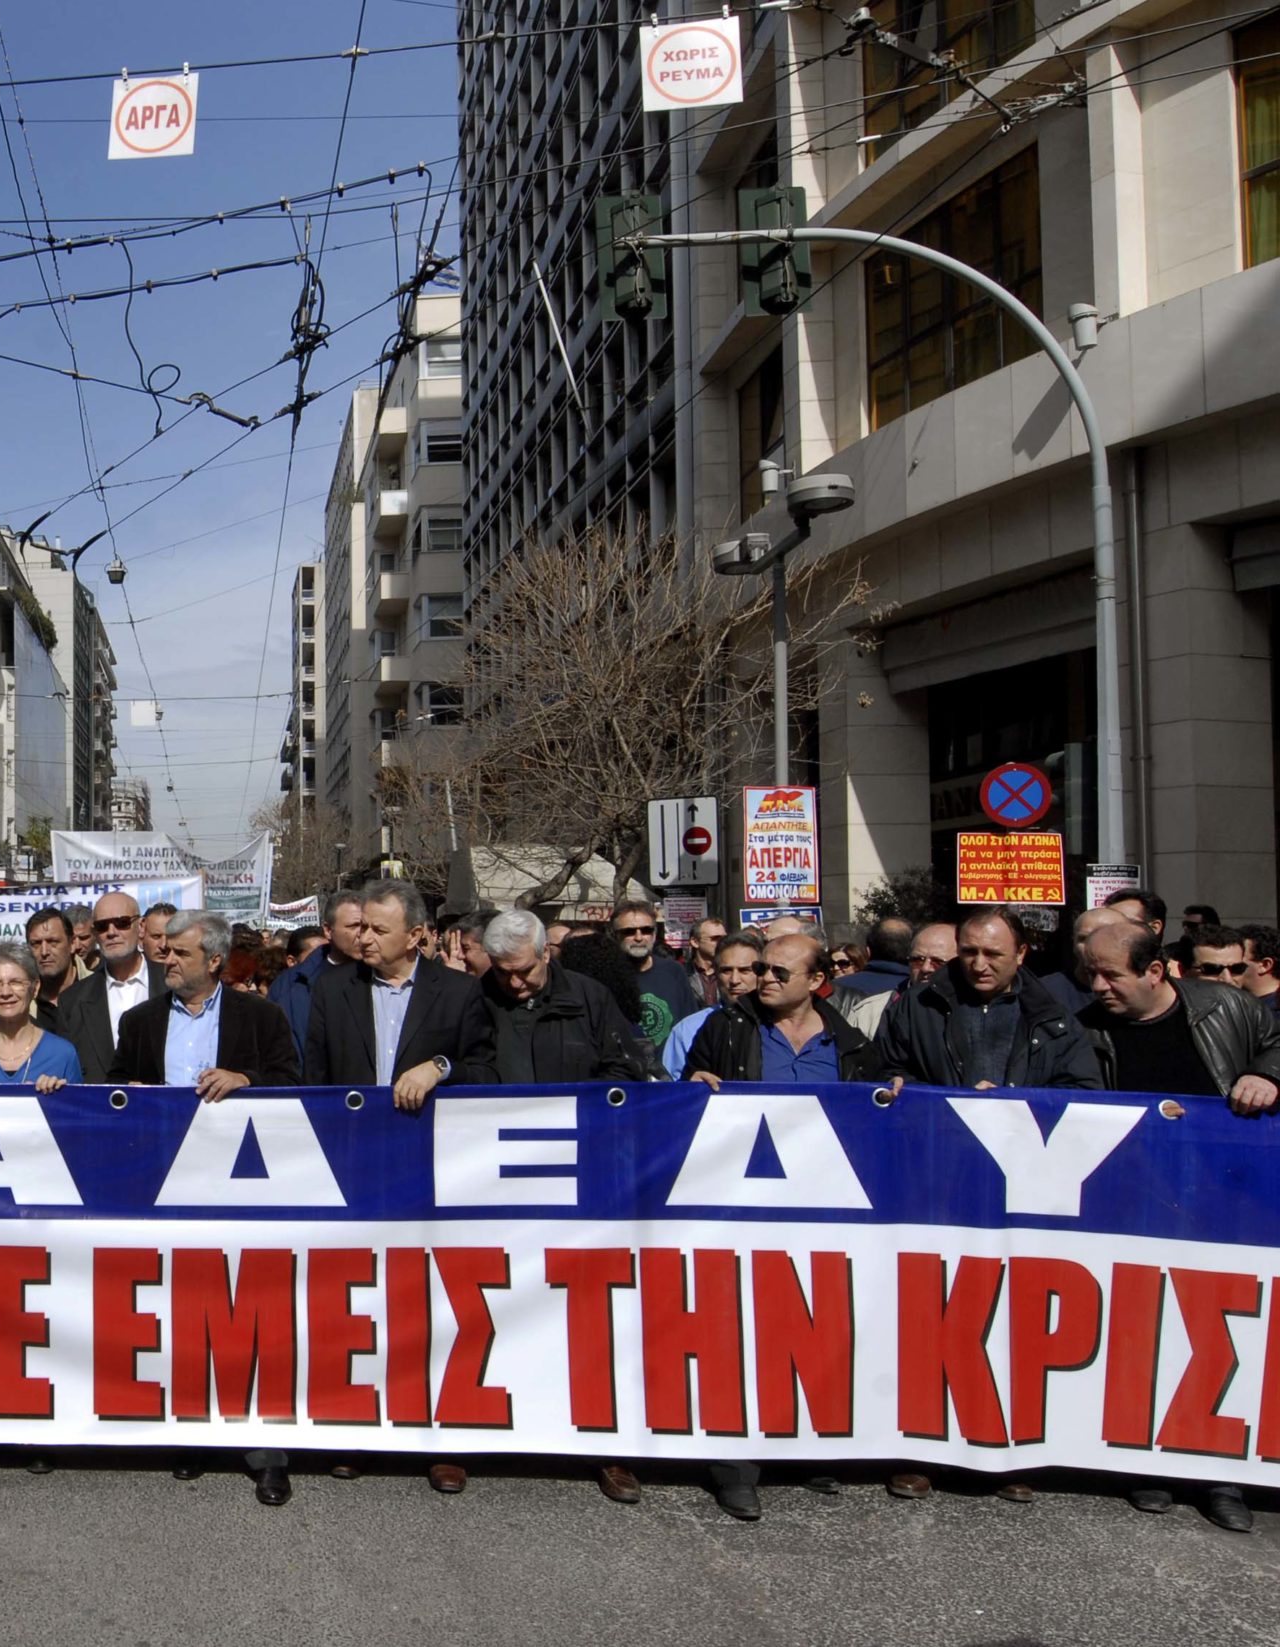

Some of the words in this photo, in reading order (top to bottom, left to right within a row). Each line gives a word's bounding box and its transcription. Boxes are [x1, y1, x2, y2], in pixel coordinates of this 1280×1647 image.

[662, 46, 720, 62] ΧΩΡΙΣ
[659, 65, 725, 83] ΡΕΥΜΑ
[125, 102, 182, 131] ΑΡΓΑ
[960, 835, 987, 846] ΟΛΟΙ
[990, 835, 1018, 846] ΣΤΟΝ
[1021, 836, 1060, 846] ΑΓΩΝΑ!
[749, 847, 811, 868] ΑΠΕΡΓΙΑ
[960, 849, 976, 858] Για
[997, 851, 1016, 859] μην
[1020, 849, 1060, 859] περάσει
[65, 858, 90, 869] ΤΟΥ
[93, 859, 161, 871] ΔΗΜΟΣΙΟΥ
[960, 863, 967, 871] η
[1021, 862, 1061, 872] επίθεση
[755, 871, 777, 883] 24
[748, 884, 799, 899] ΟΜΟΝΟΙΑ
[960, 886, 997, 900] Μ-Λ
[1004, 887, 1044, 900] ΚΚΕ
[92, 1247, 513, 1429] ΕΜΕΙΣ
[545, 1248, 855, 1438] ΤΗΝ
